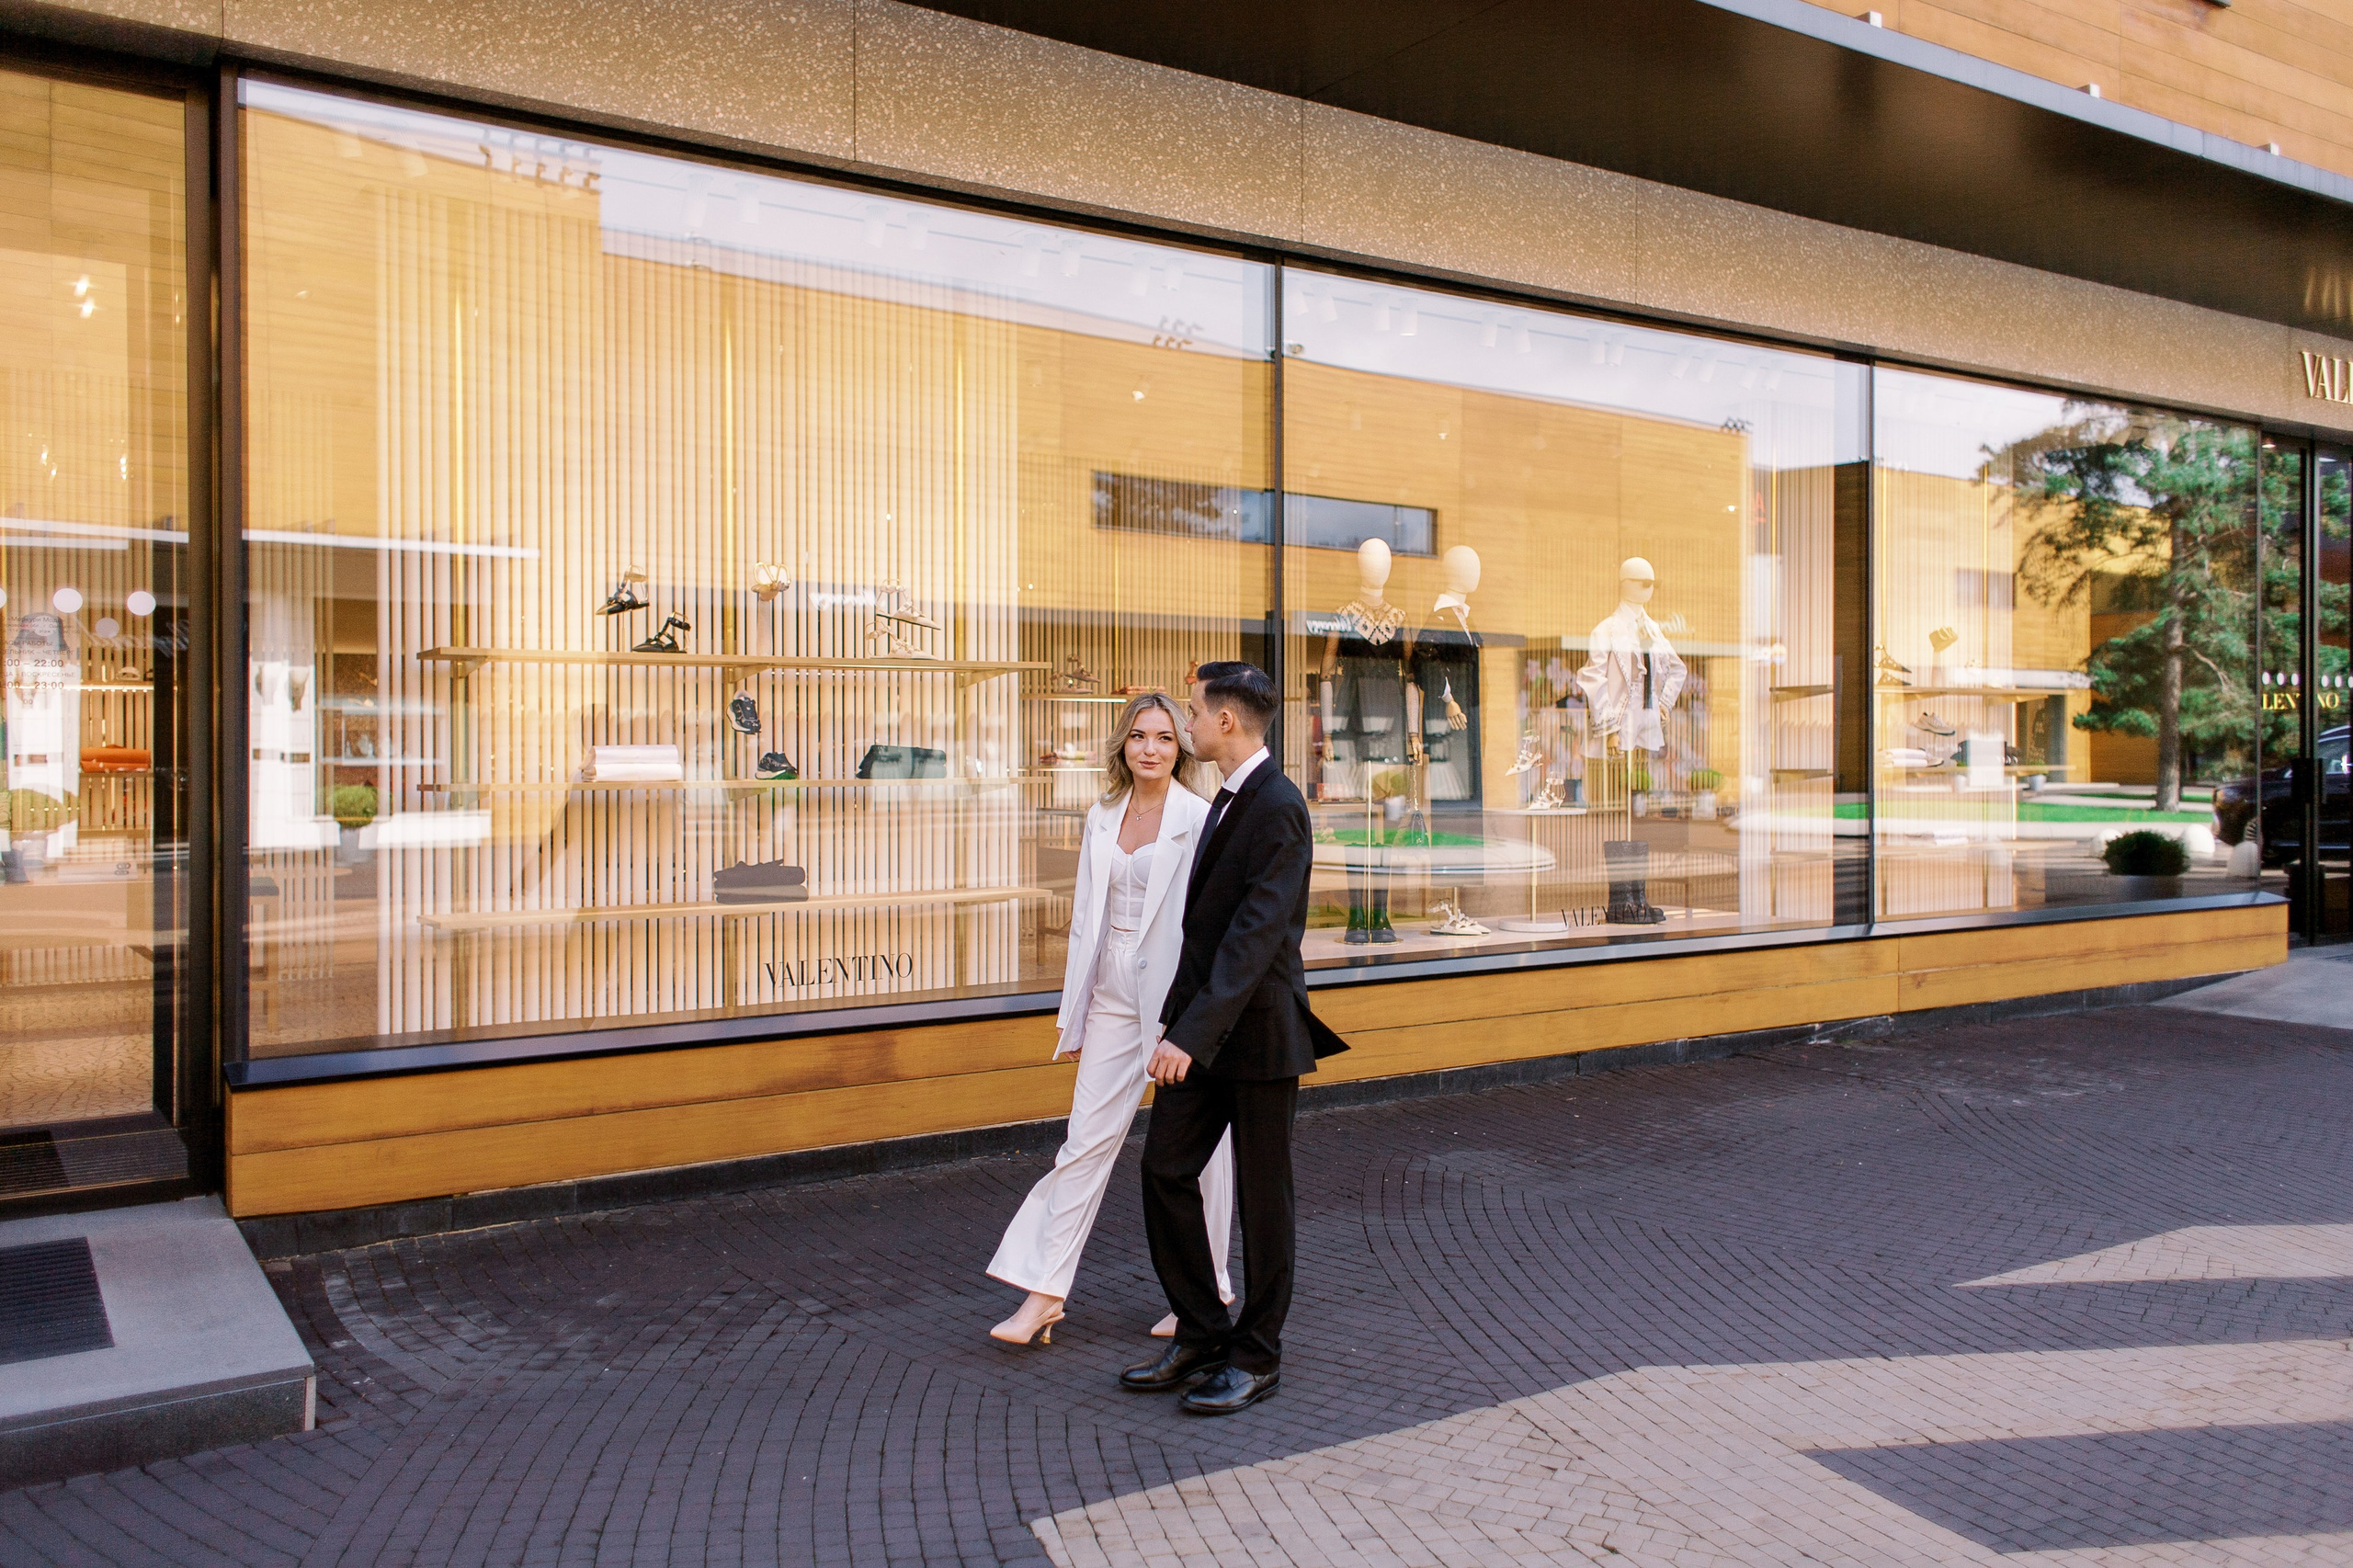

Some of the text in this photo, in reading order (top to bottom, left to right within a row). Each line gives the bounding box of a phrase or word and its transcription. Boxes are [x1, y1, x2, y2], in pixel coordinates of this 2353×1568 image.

[2300, 350, 2353, 405] VAL
[34, 659, 64, 668] 22:00
[34, 681, 64, 690] 23:00
[763, 952, 914, 988] VALENTINO
